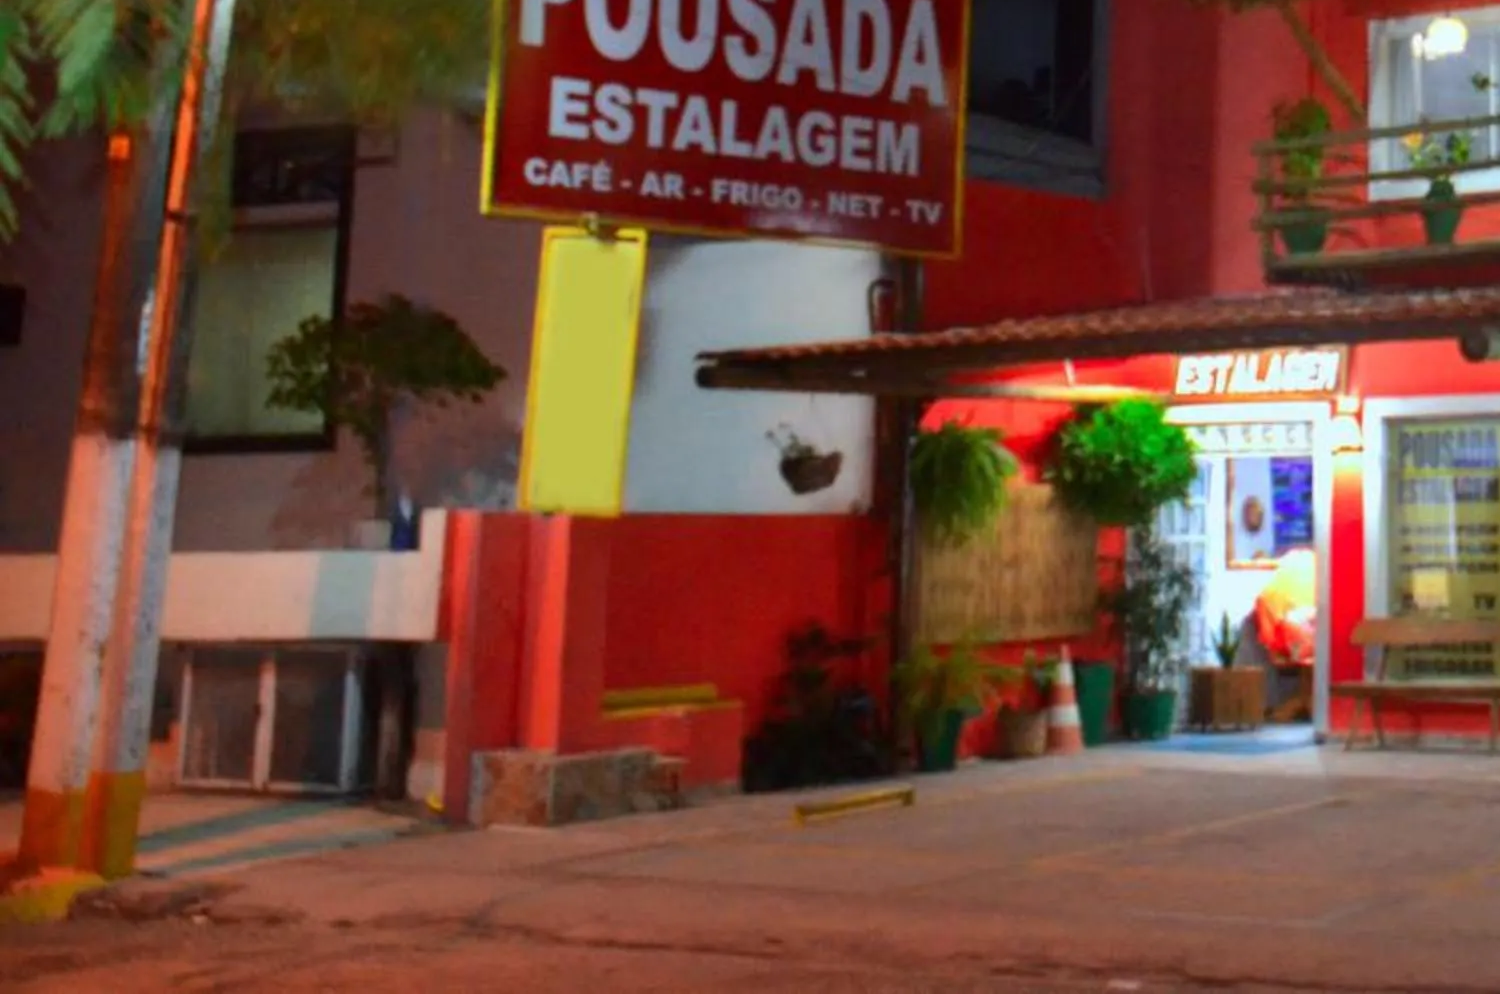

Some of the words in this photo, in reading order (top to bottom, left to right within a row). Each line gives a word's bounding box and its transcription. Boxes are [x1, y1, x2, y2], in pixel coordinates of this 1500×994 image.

[548, 75, 921, 177] ESTALAGEM
[523, 157, 613, 193] CAFÉ
[640, 172, 685, 200] AR
[711, 180, 802, 210] FRIGO
[826, 191, 884, 220] NET
[905, 199, 944, 226] TV
